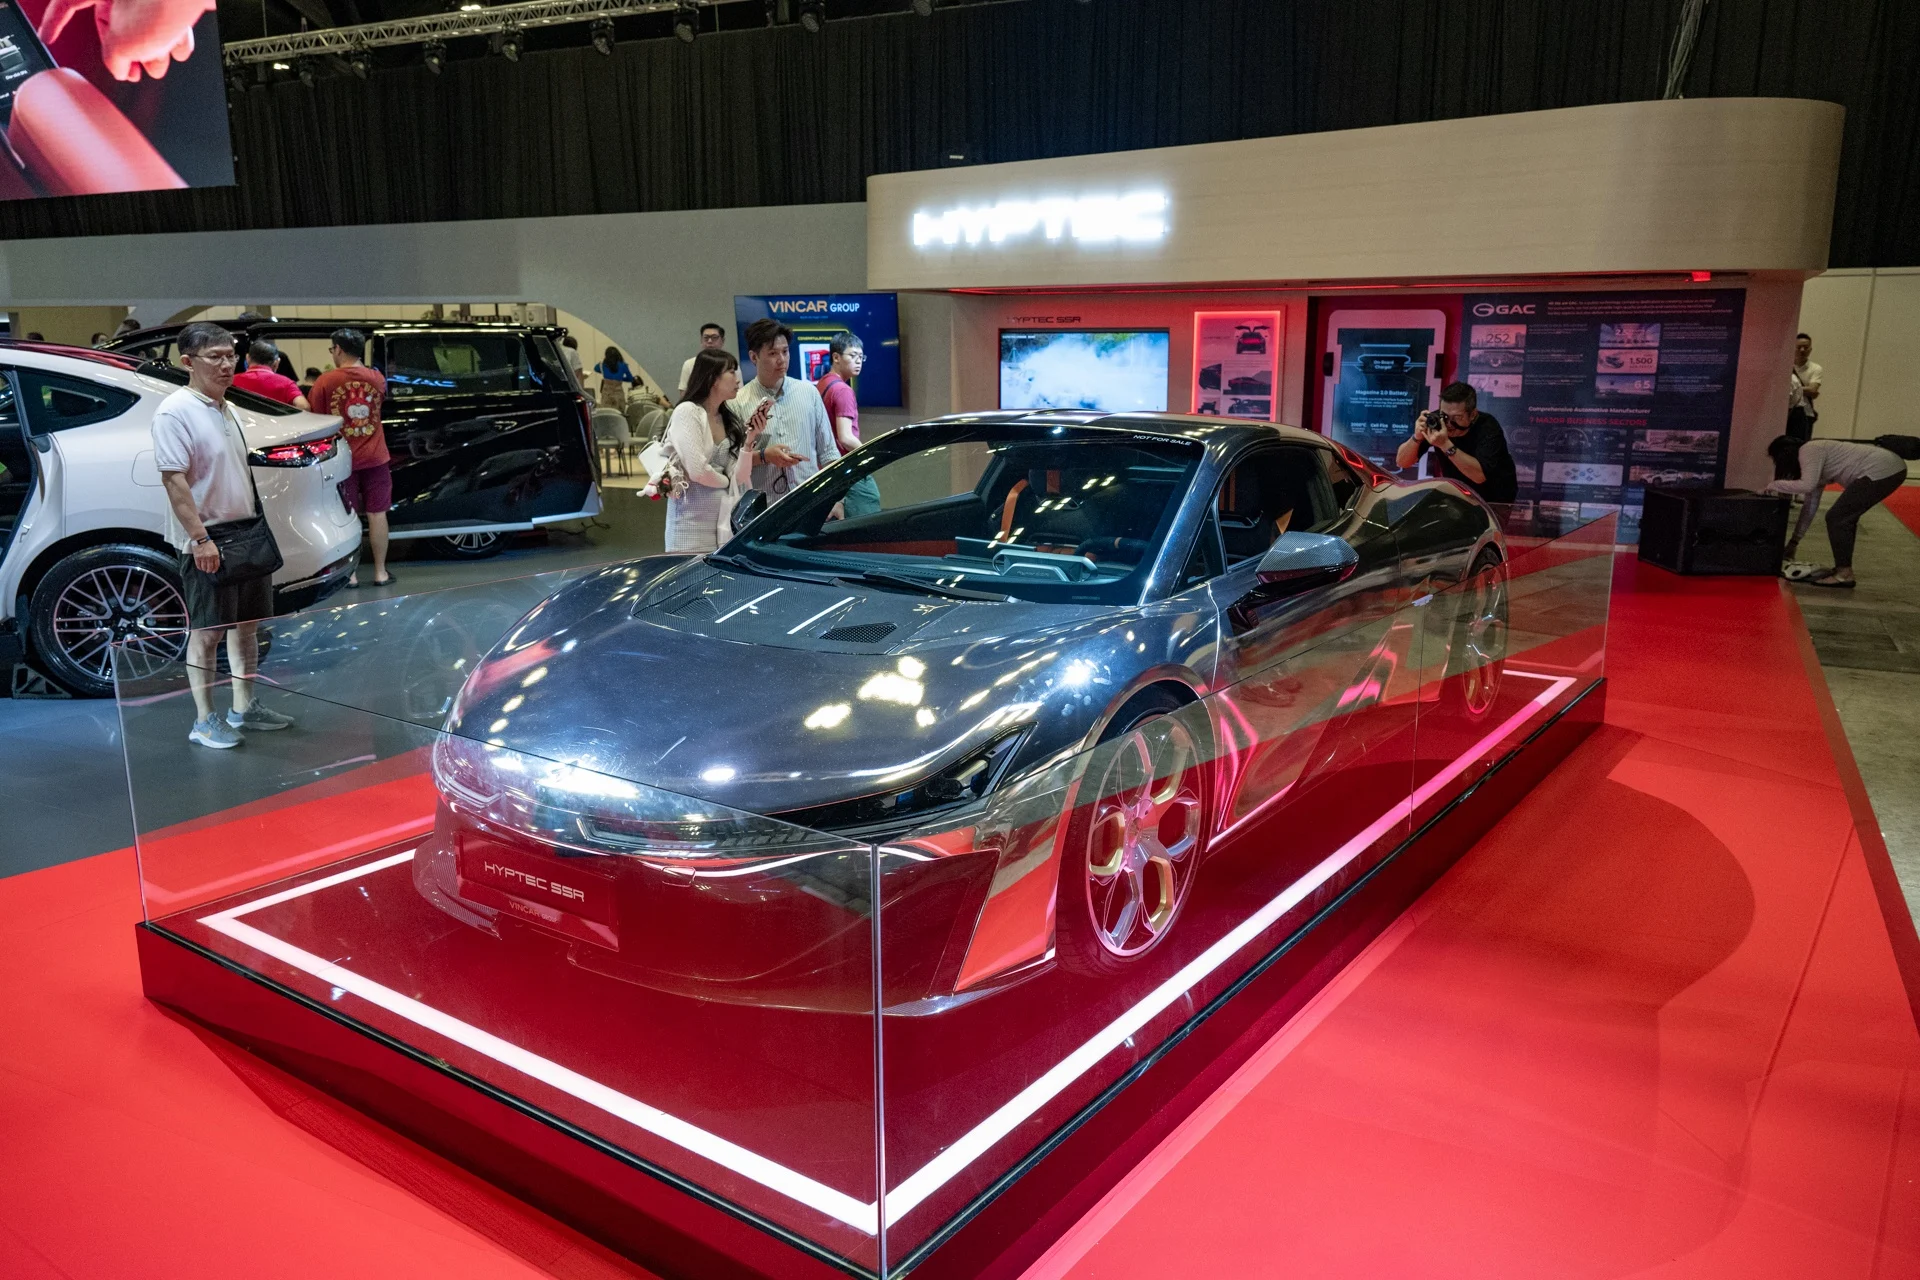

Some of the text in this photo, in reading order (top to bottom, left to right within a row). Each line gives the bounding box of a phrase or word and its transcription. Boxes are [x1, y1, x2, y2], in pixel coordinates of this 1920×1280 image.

[912, 191, 1168, 246] HYPTEC
[830, 303, 860, 312] GROUP
[1496, 304, 1536, 315] GAC
[1486, 333, 1510, 344] 252
[484, 861, 585, 903] HYPTEC SSR
